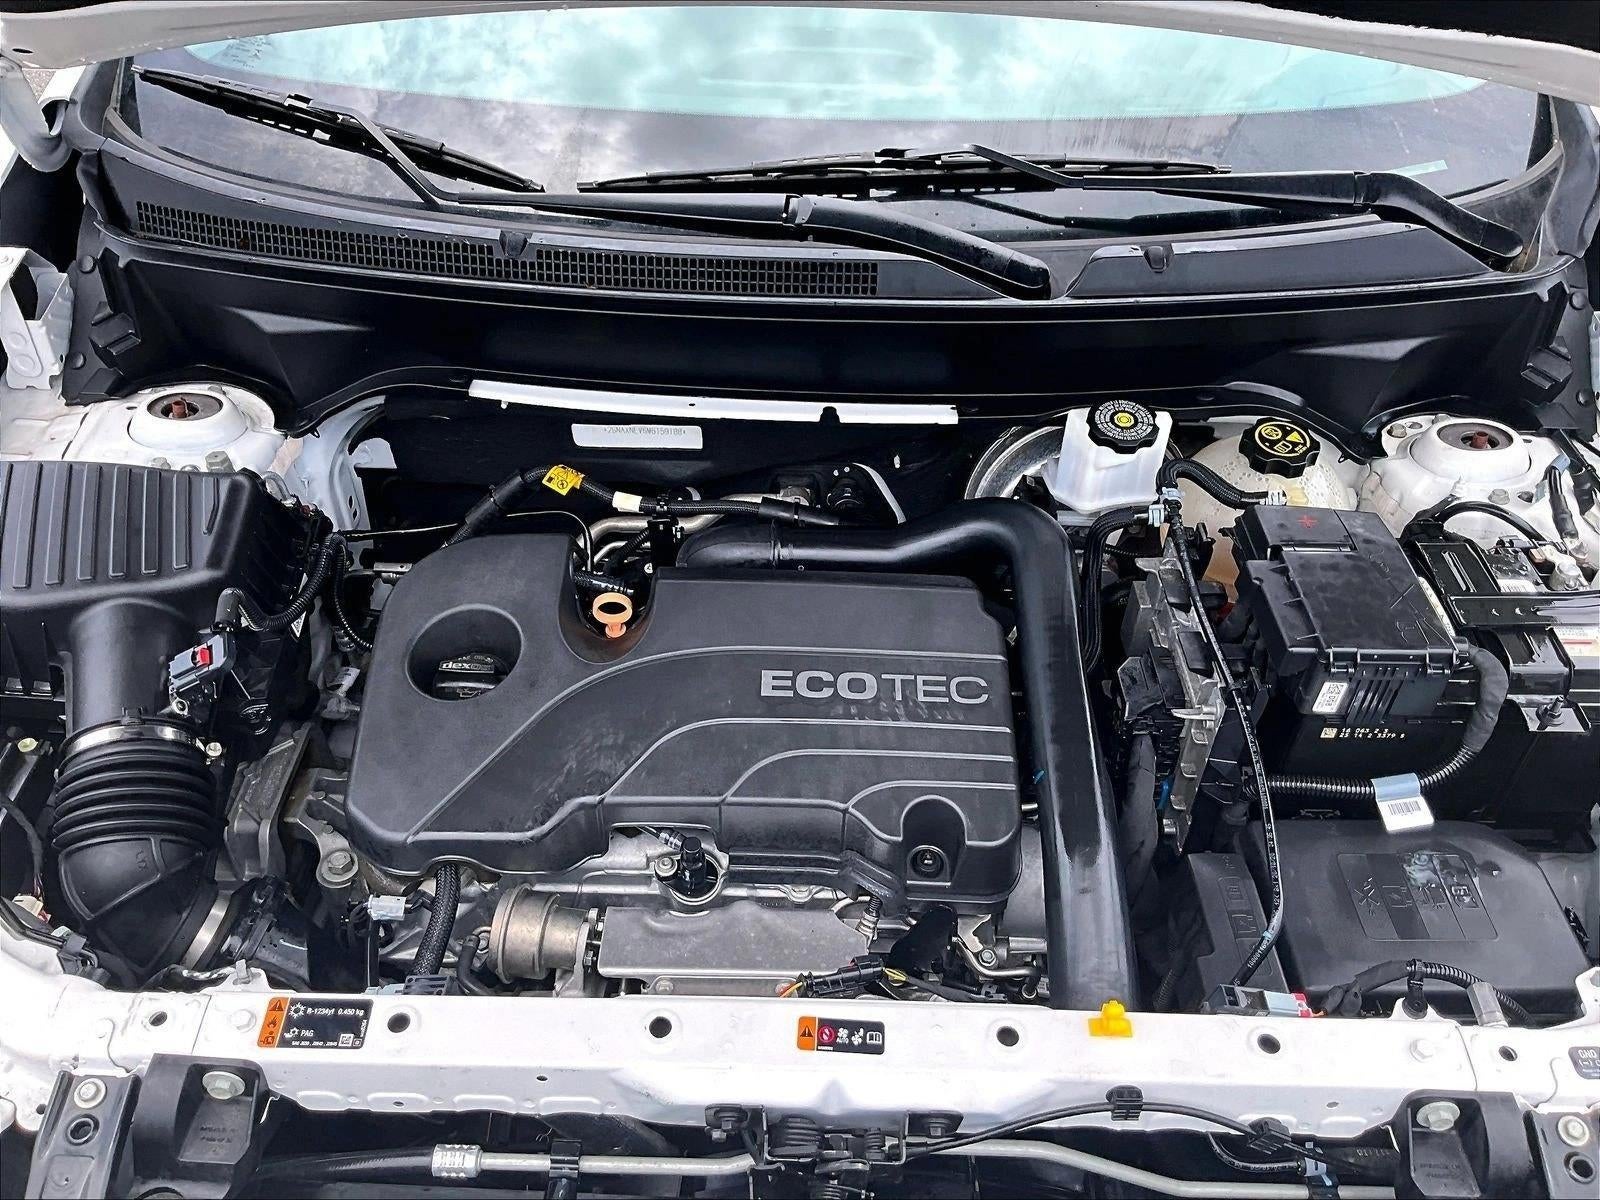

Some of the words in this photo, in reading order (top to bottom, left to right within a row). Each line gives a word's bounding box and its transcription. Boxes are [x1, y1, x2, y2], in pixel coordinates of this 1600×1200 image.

[760, 669, 989, 704] ECOTEC
[337, 1008, 355, 1016] 0.450
[355, 1009, 365, 1017] kg
